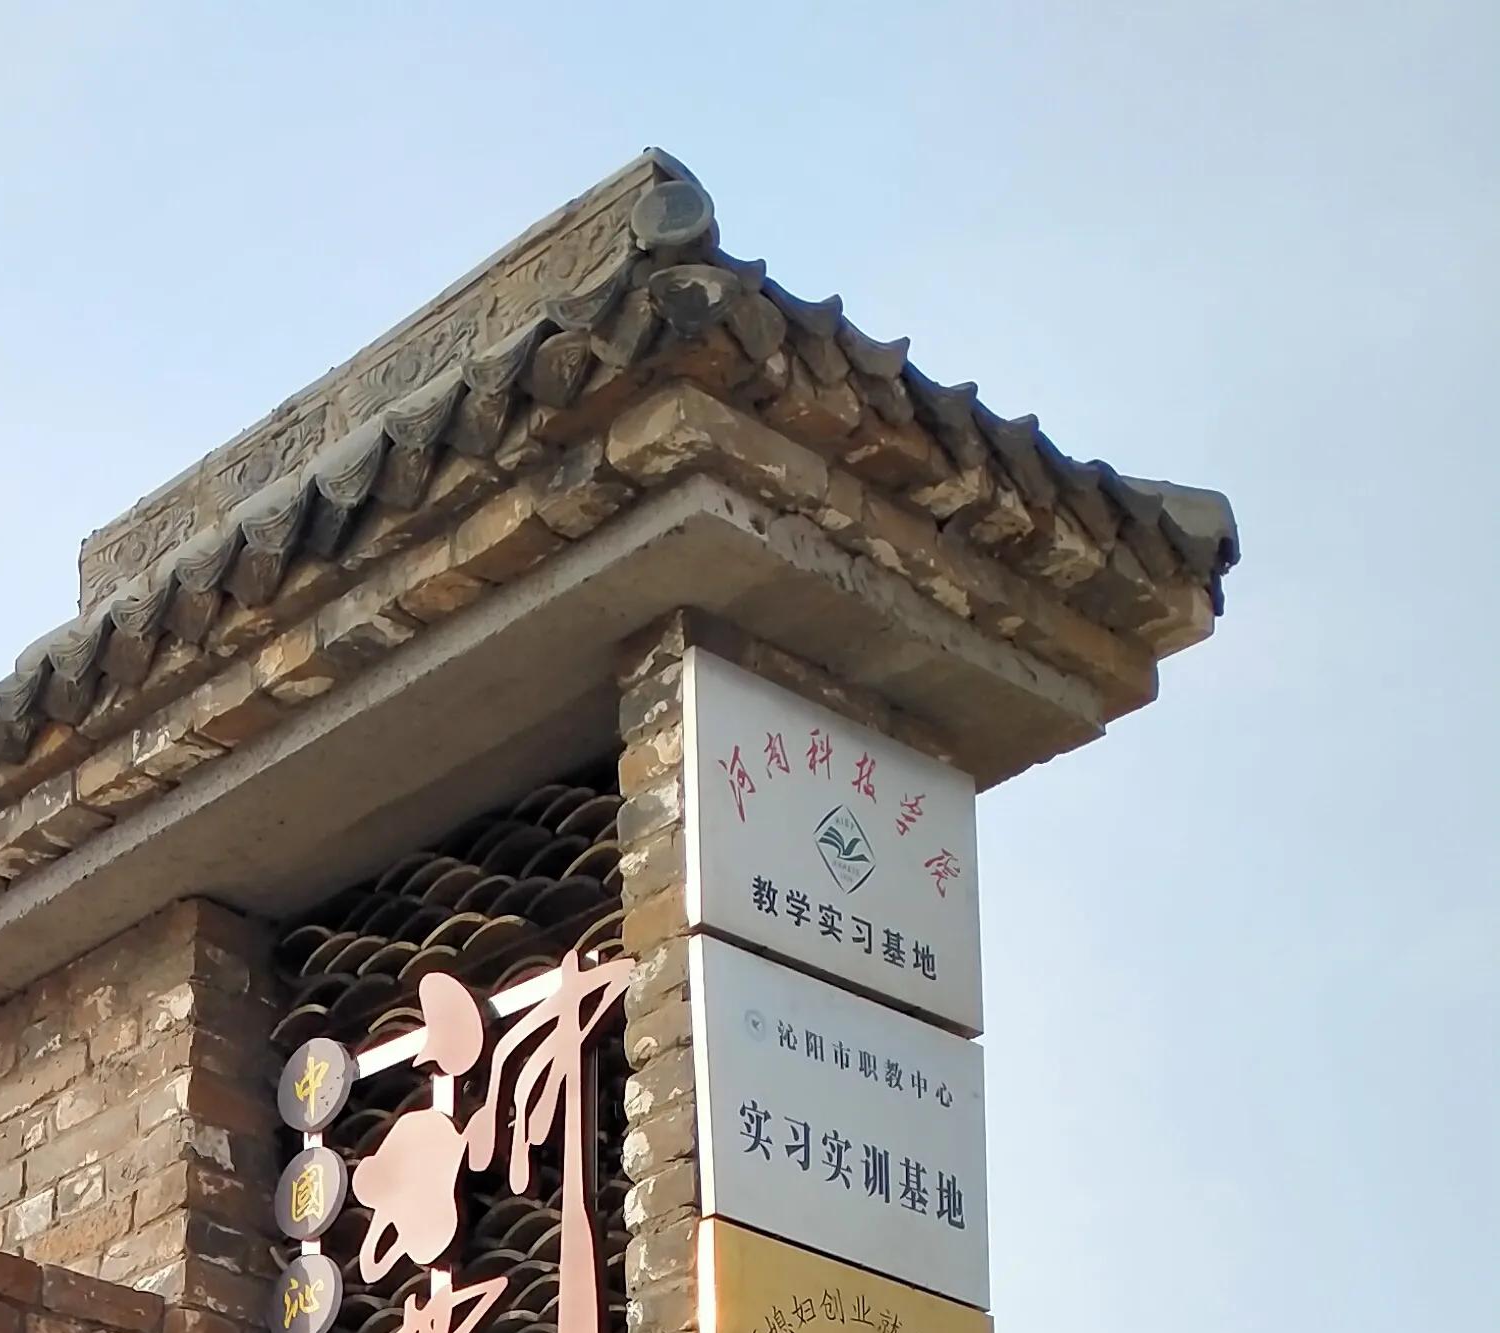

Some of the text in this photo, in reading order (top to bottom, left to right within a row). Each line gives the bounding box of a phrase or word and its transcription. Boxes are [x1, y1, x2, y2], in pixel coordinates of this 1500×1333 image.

[752, 876, 937, 982] 教学实习基地
[777, 1018, 954, 1108] 沁阳市职教中心
[738, 1100, 965, 1230] 实习实训基地
